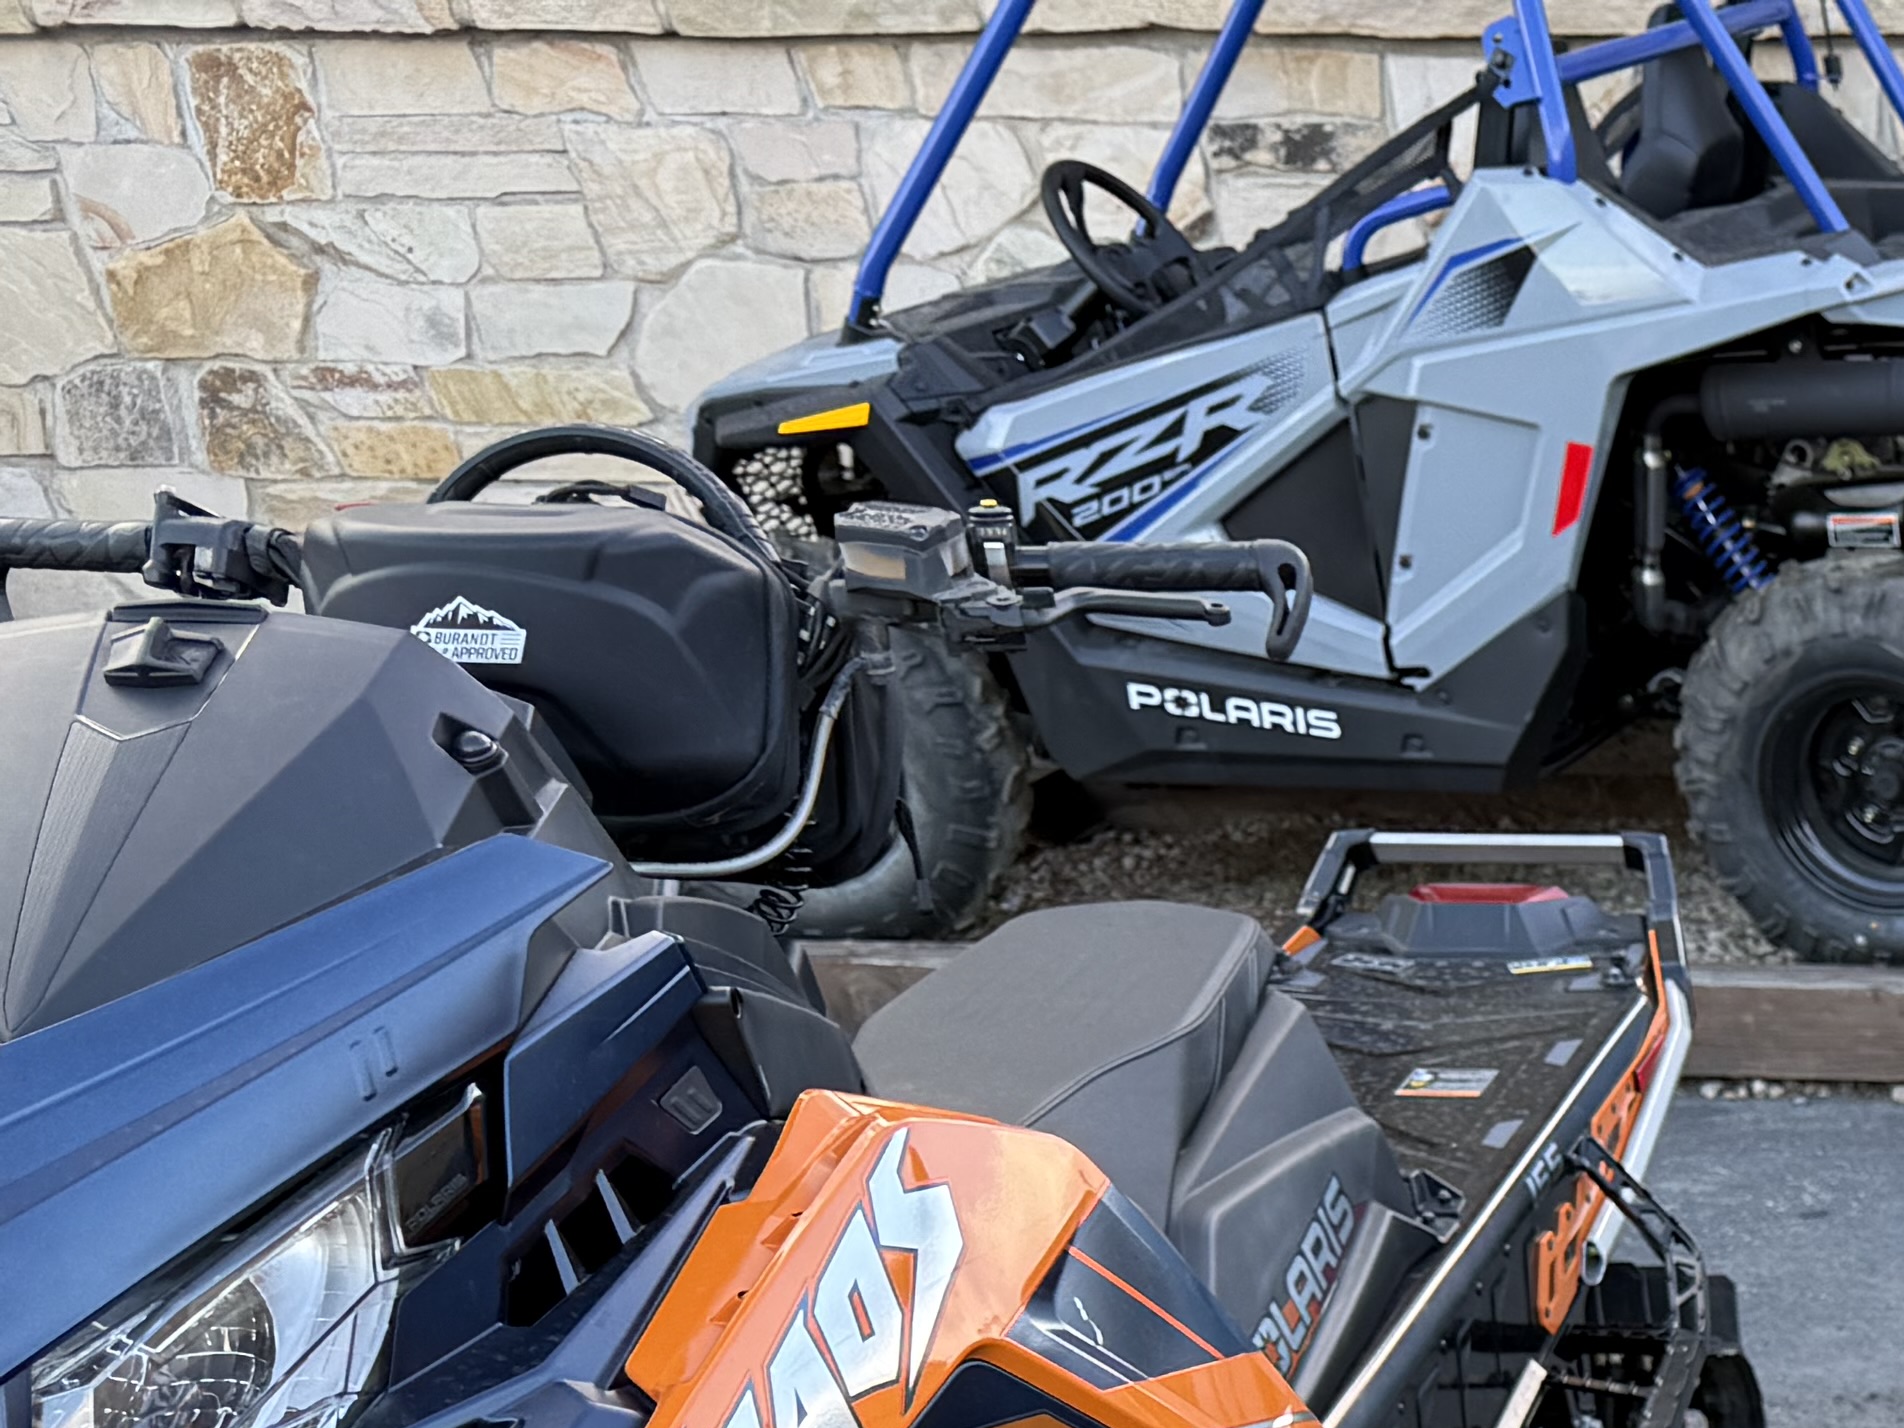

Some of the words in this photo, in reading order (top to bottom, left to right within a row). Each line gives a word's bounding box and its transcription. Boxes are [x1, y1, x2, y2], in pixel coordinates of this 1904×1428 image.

[1017, 374, 1274, 528] RZR
[1071, 475, 1162, 528] 200
[434, 631, 498, 646] BURANDT
[451, 646, 519, 661] APPROVED
[1126, 681, 1342, 740] POLARIS
[1251, 1172, 1355, 1376] OLARIS
